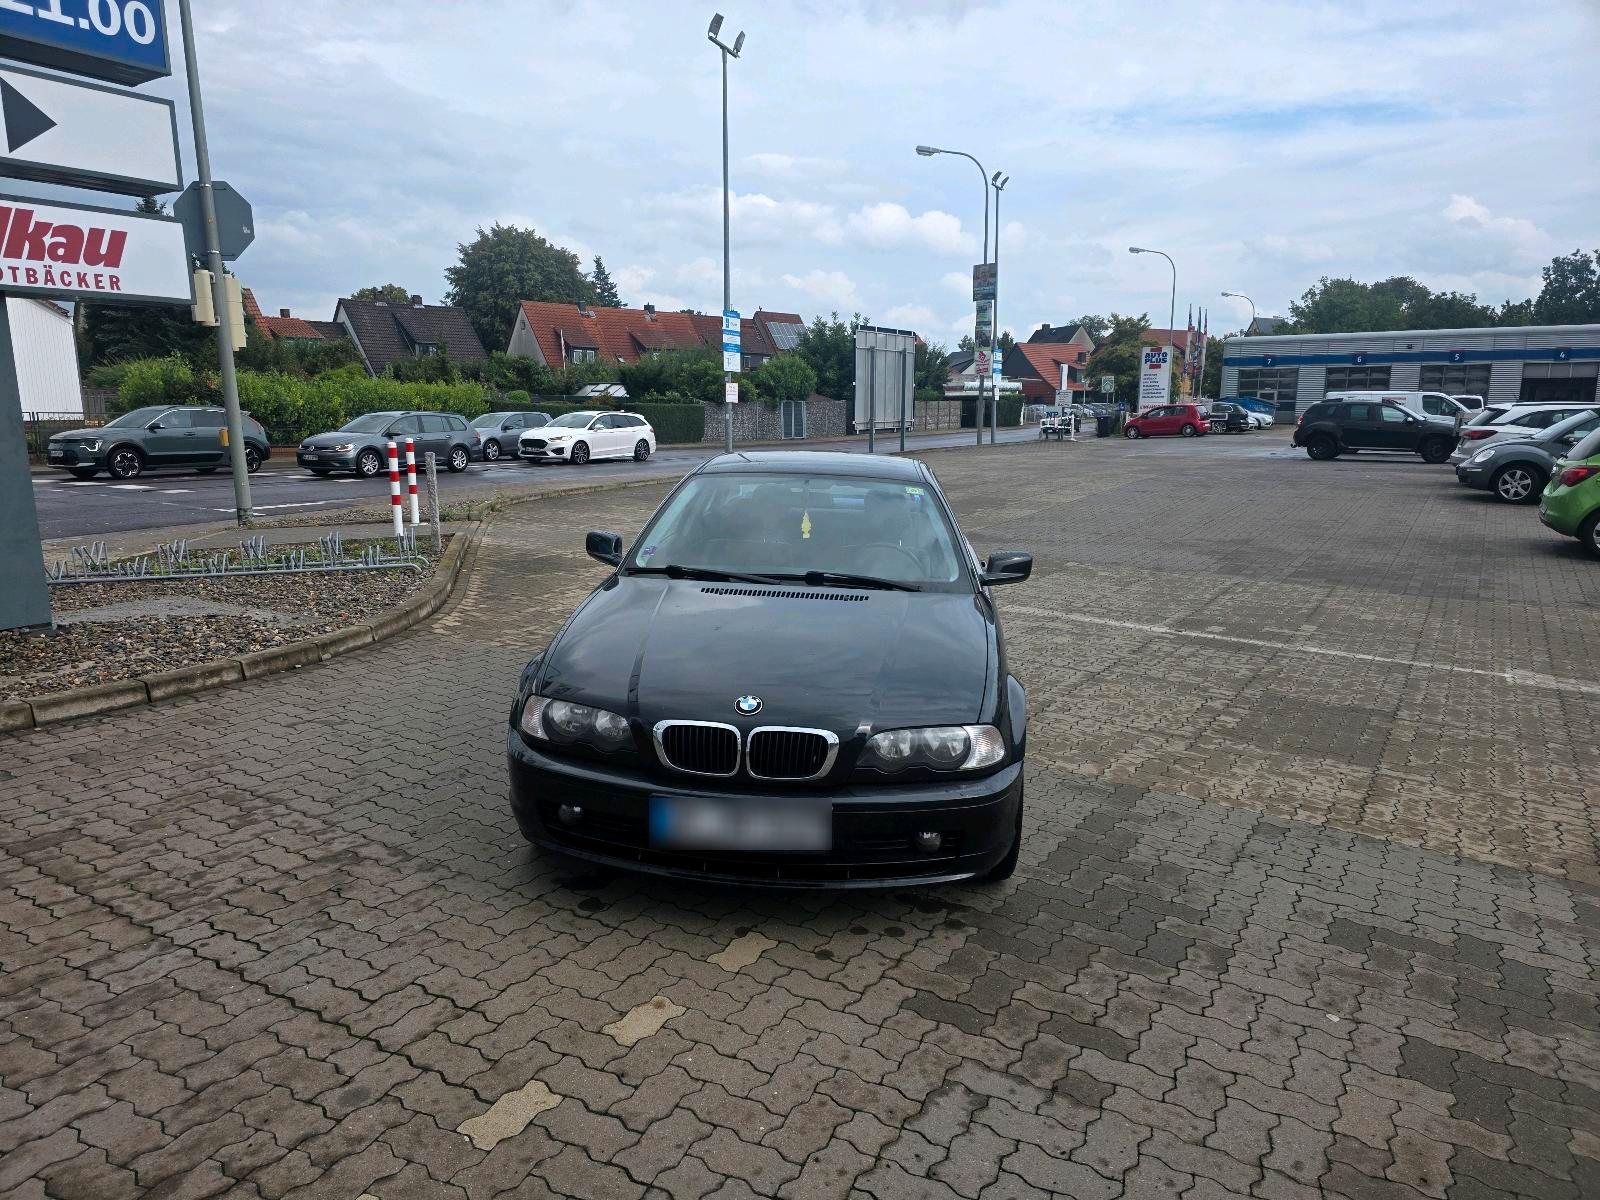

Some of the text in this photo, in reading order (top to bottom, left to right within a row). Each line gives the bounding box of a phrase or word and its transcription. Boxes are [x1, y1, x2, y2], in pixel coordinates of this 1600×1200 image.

[0, 0, 156, 45] 1.00
[0, 265, 121, 291] TBÄCKER
[1454, 353, 1460, 361] 5
[1559, 351, 1565, 359] 4
